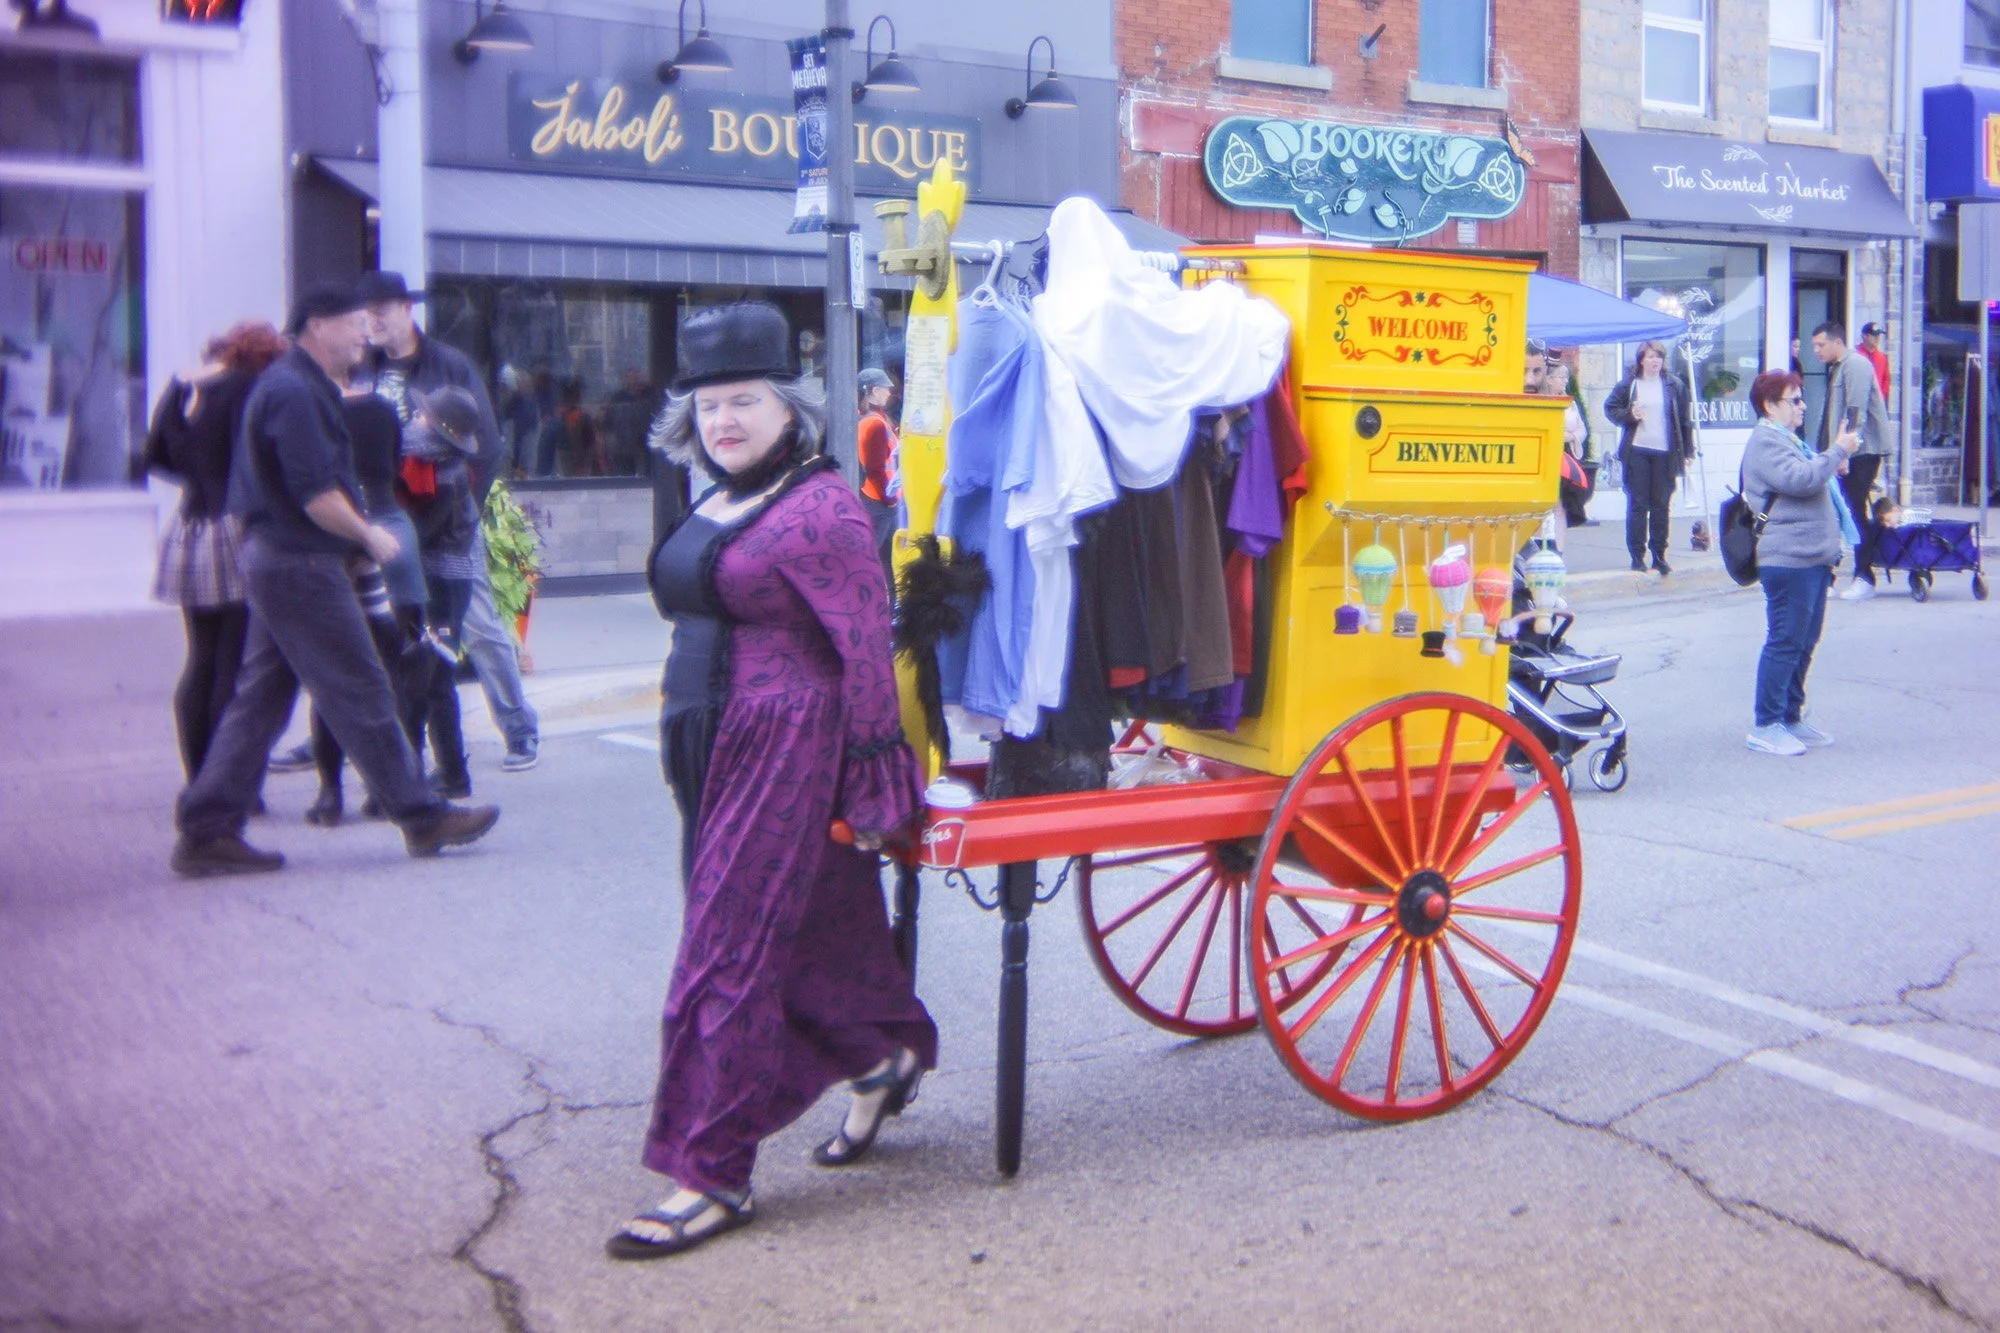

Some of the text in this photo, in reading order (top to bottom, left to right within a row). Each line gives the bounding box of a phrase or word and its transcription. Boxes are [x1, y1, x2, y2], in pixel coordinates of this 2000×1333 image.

[791, 66, 827, 89] MEDIEVA
[531, 80, 968, 179] Jaboli BOUIQUE
[808, 167, 828, 177] SATUR
[1652, 162, 1847, 201] The Scented Market
[1368, 315, 1468, 341] WELCOME
[1720, 400, 1749, 421] MORE
[1396, 441, 1515, 465] BENVENUTI
